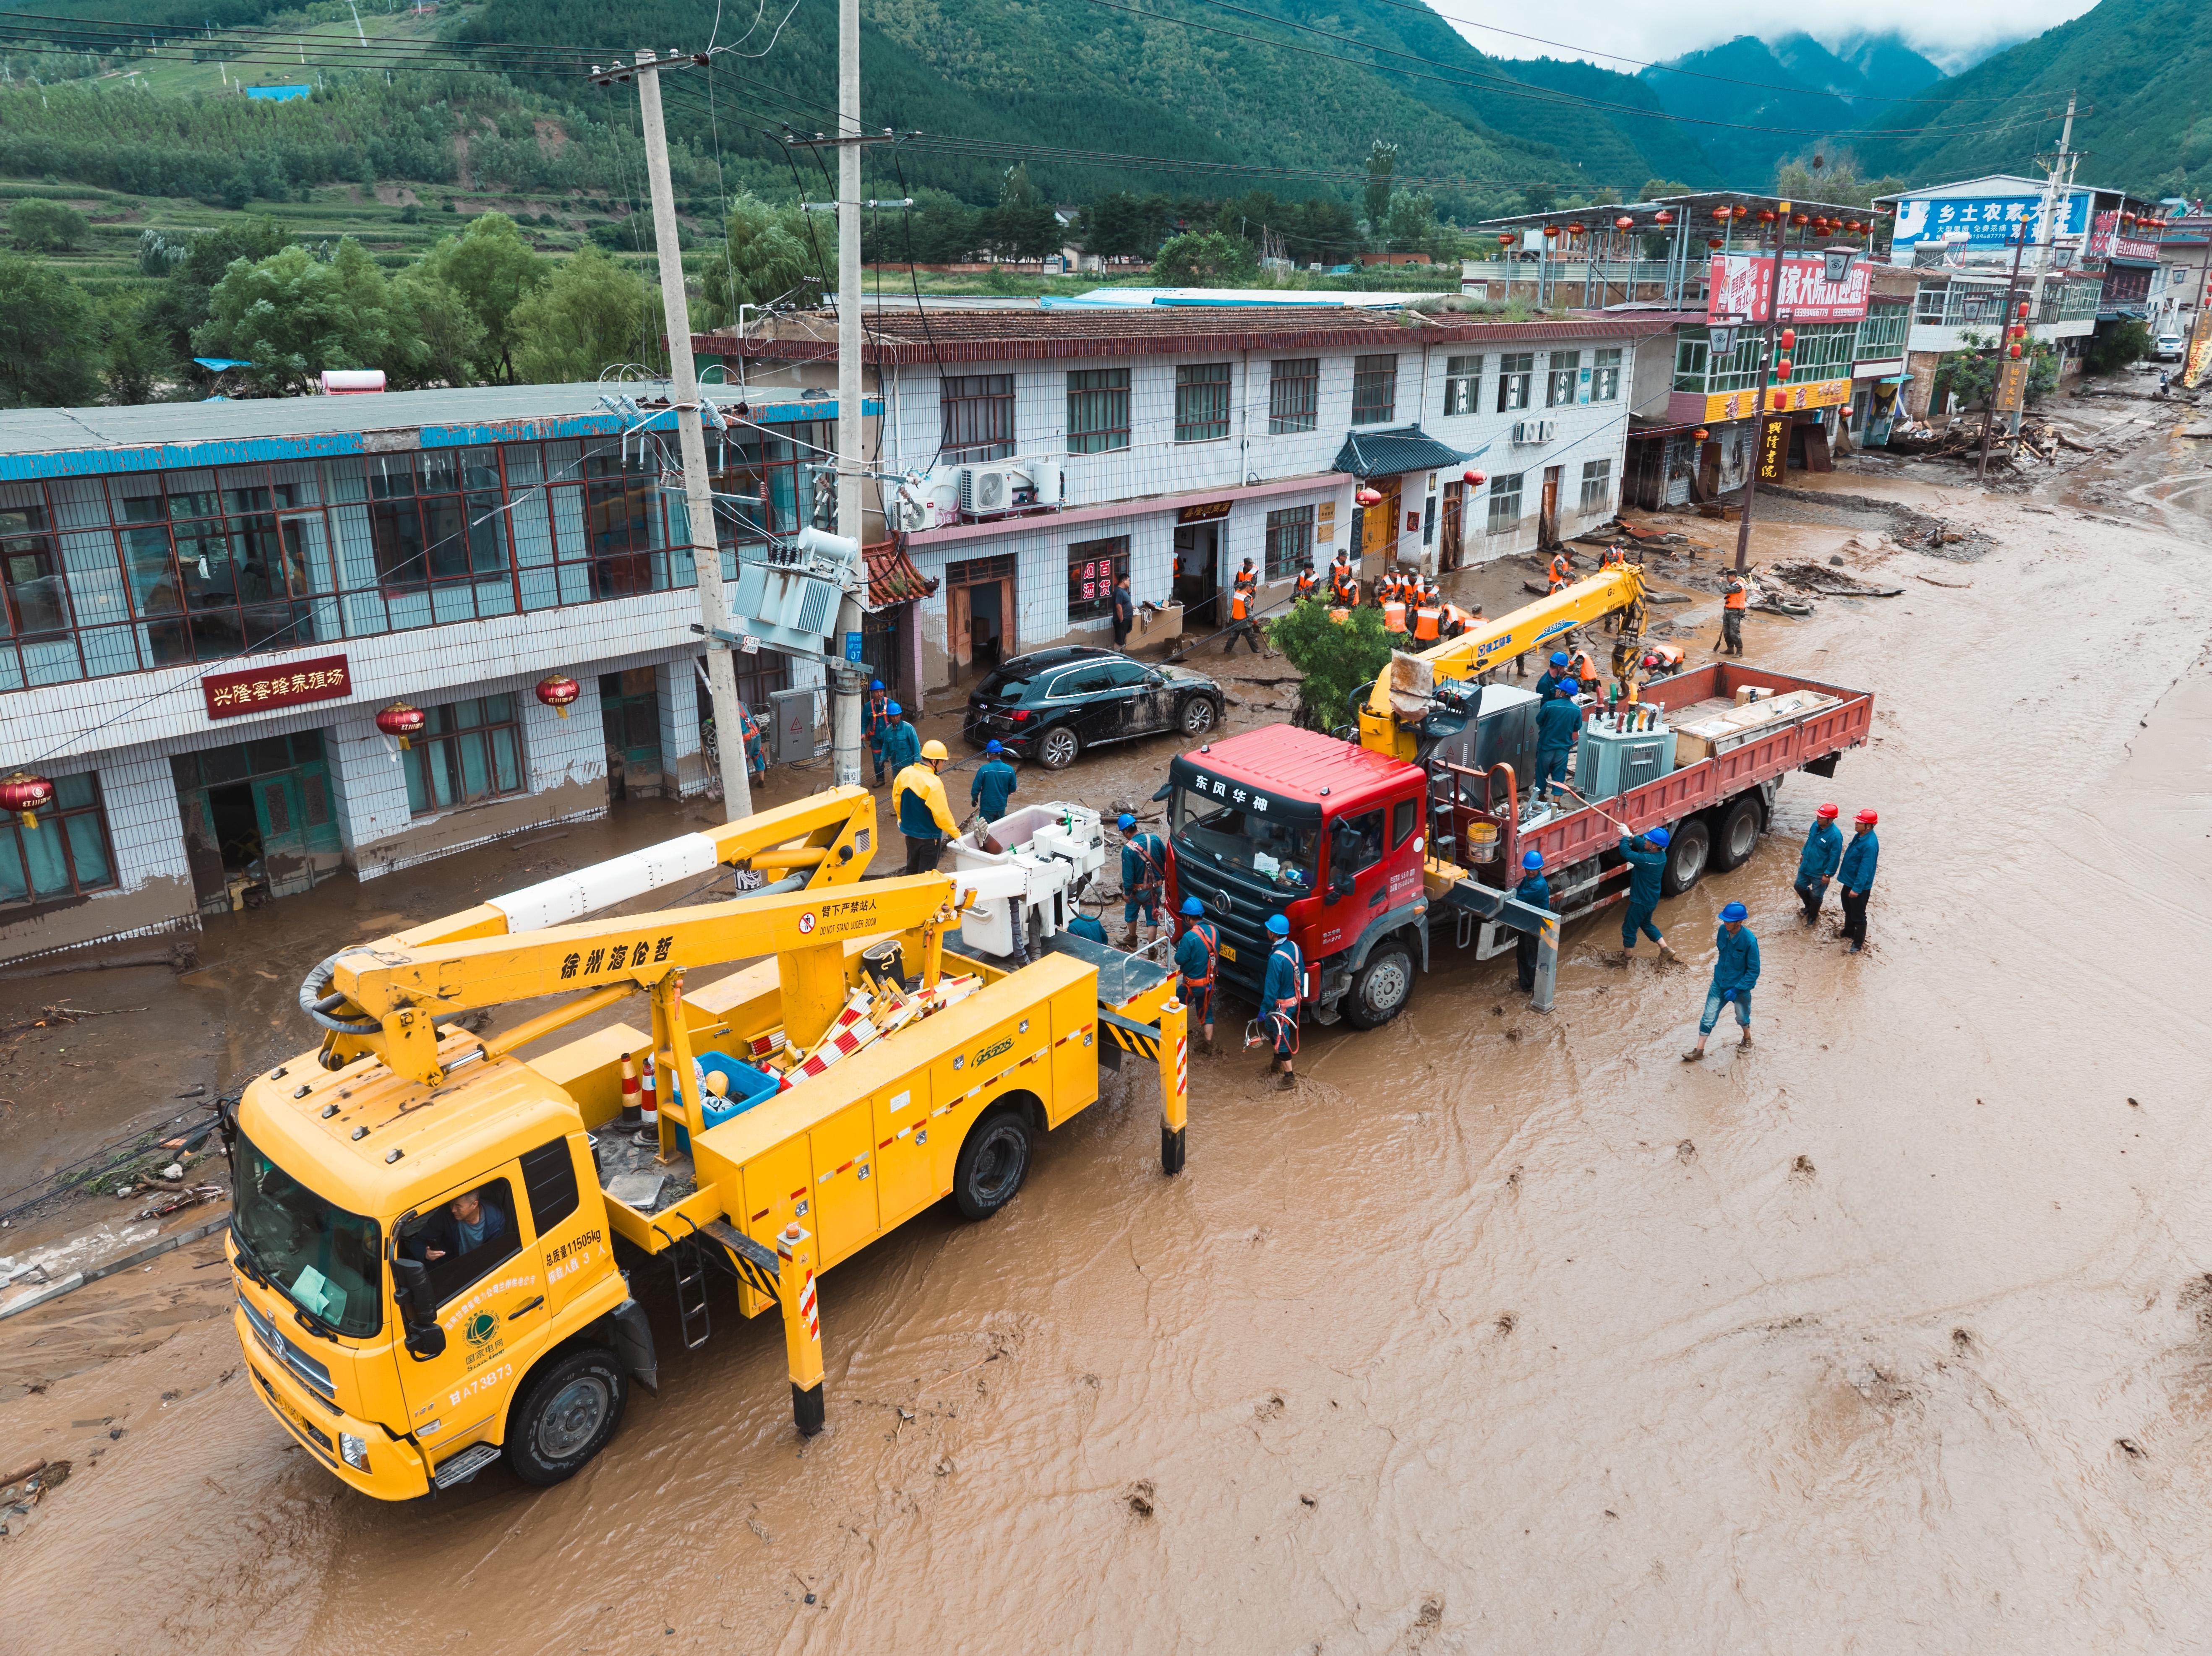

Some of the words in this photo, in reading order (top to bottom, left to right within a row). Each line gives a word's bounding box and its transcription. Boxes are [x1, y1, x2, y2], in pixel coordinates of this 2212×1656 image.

[2090, 214, 2116, 252] 餐饮
[2005, 368, 2020, 405] 杨家大院
[1543, 620, 1565, 635] SQS350
[851, 651, 861, 659] 07
[214, 669, 344, 706] 兴隆蜜蜂养殖场
[1196, 775, 1268, 811] 东风华神
[820, 927, 826, 935] DO
[827, 925, 835, 935] NOT
[836, 922, 849, 932] STAND
[865, 917, 876, 927] BOOM
[822, 899, 876, 918] 臂下严禁站人
[561, 936, 673, 979] 徐州海伦哲
[1221, 946, 1235, 960] 8544
[976, 1038, 1012, 1066] 95598
[546, 1229, 601, 1267] 总质量11505kg
[548, 1257, 579, 1285] 核载人数
[583, 1252, 590, 1264] 3
[597, 1244, 605, 1257] 人
[444, 1276, 536, 1331] 国网甘肃省电力公司兰州供电公司
[466, 1338, 503, 1365] 国家电网
[449, 1364, 512, 1406] 甘A73873
